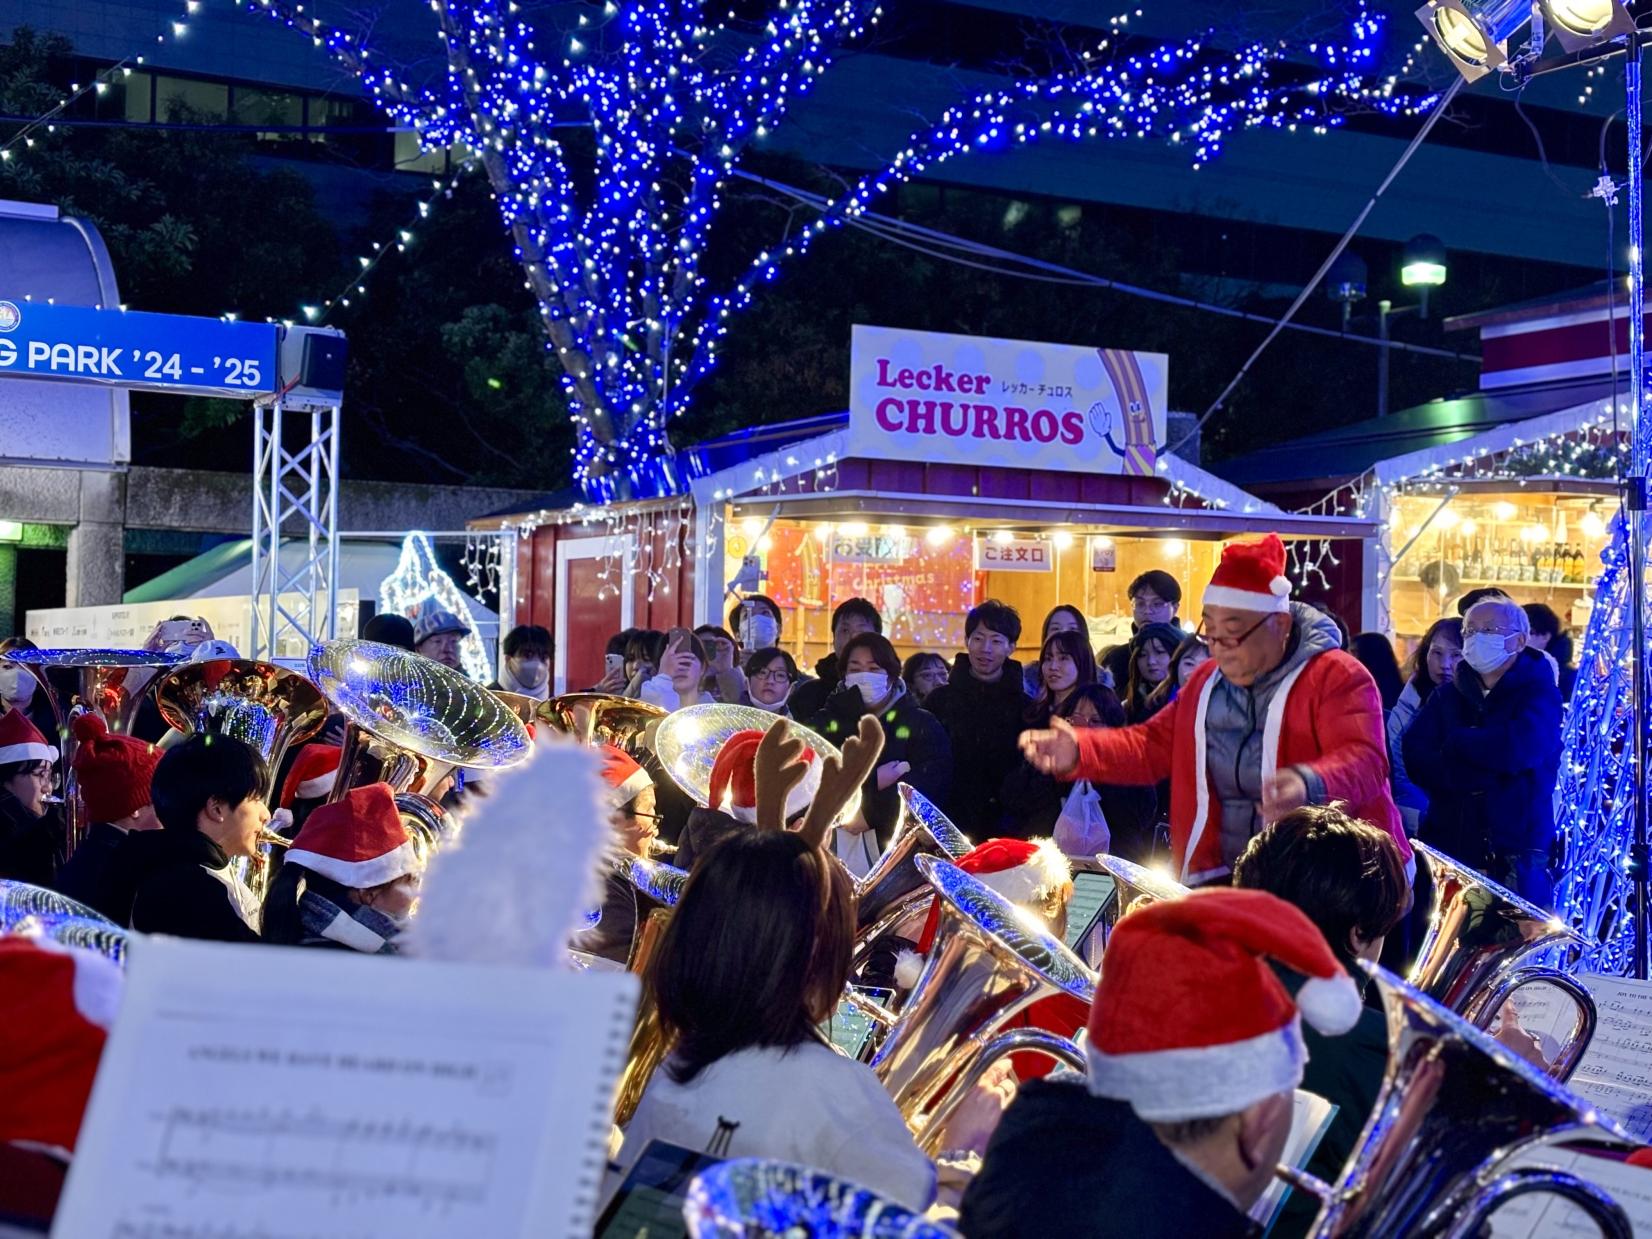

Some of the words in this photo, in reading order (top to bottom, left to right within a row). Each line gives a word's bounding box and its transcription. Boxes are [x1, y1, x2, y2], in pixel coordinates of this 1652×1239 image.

[29, 341, 122, 375] PARK
[132, 350, 182, 379] '24
[213, 357, 261, 387] '25
[876, 359, 991, 395] Lecker
[876, 397, 1084, 445] CHURROS
[984, 547, 1044, 562] ご注文口
